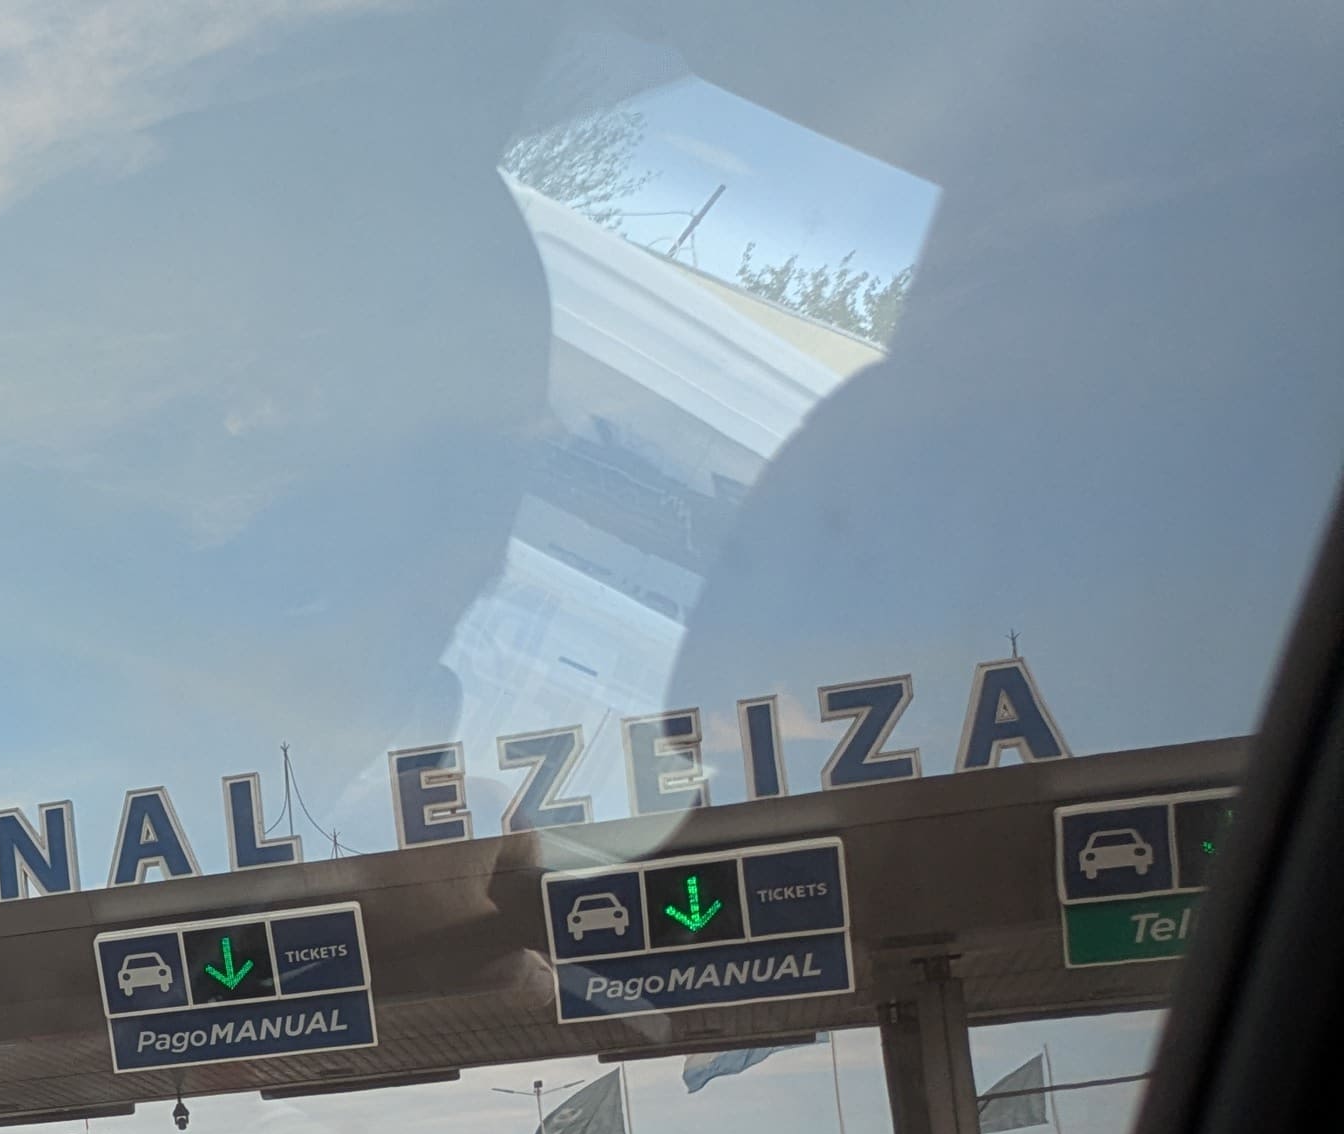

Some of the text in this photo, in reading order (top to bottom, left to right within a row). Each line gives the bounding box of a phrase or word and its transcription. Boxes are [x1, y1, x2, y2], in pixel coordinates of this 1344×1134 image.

[388, 656, 1076, 851] EZEIZA
[757, 880, 827, 903] TICKETS
[1131, 908, 1191, 944] Tel
[285, 942, 348, 963] TICKETS
